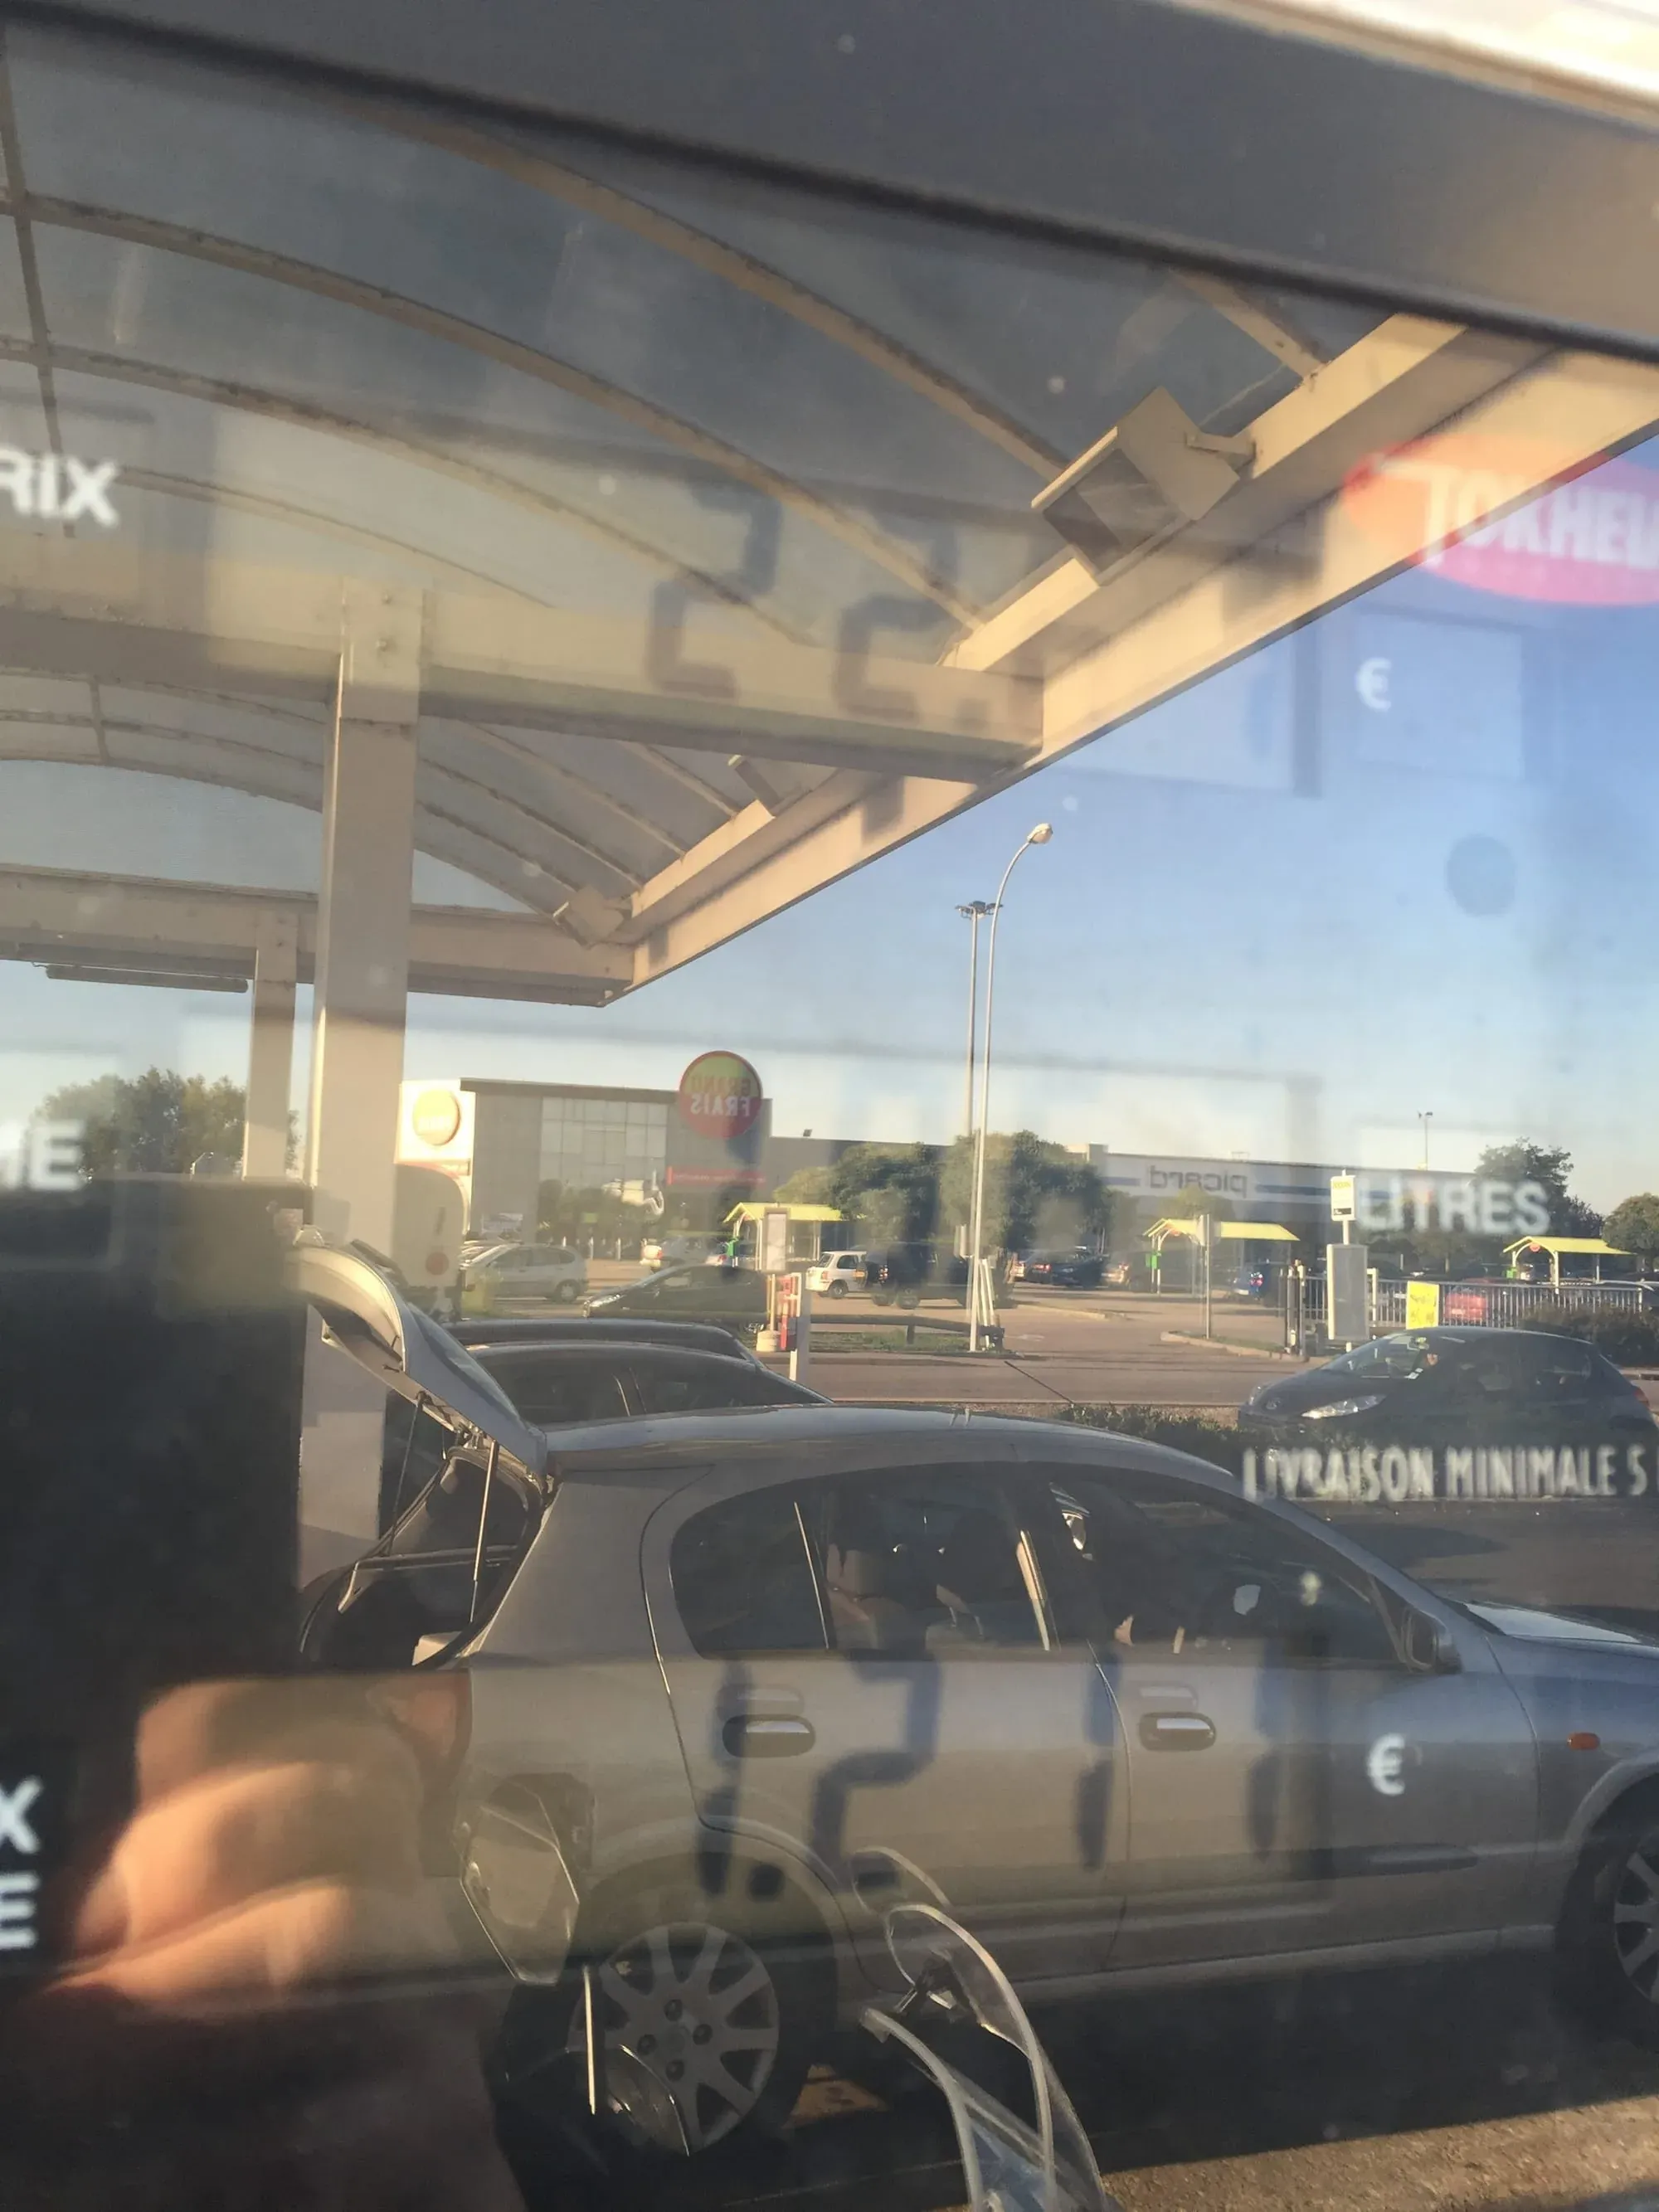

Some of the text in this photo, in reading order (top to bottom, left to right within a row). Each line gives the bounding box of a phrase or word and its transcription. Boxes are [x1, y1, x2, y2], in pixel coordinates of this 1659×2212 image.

[1355, 658, 1391, 712] €
[1358, 1178, 1550, 1234] LITRES
[1242, 1446, 1433, 1501] LIVRAISON
[1446, 1444, 1618, 1498] MINIMALE
[1368, 1730, 1405, 1796] €
